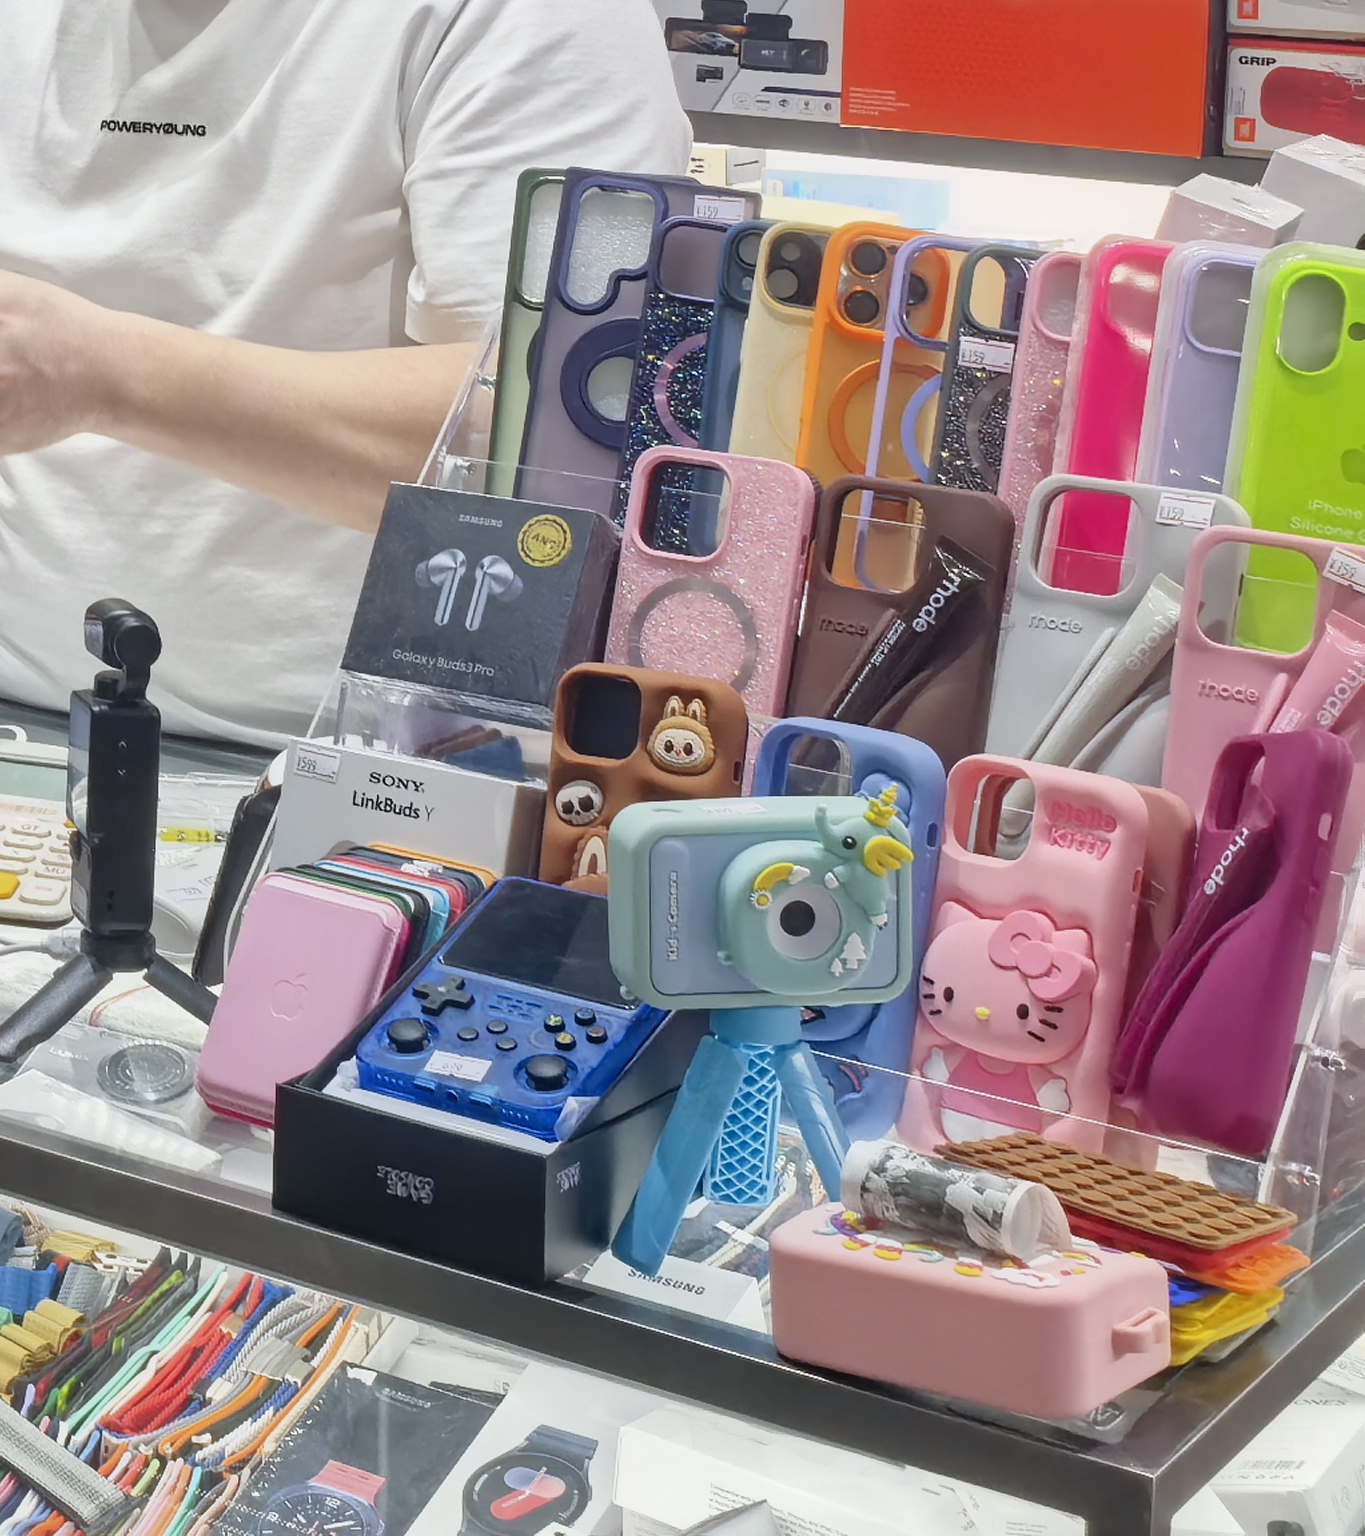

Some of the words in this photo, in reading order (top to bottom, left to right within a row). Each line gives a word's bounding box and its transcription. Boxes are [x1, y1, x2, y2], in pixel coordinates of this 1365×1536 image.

[1238, 55, 1277, 67] GRIP
[459, 513, 503, 528] SAMSUNG
[1308, 499, 1363, 520] iPhone
[1290, 517, 1354, 540] Silicone
[912, 571, 962, 633] rhode
[392, 648, 436, 668] Galaxy
[437, 655, 472, 673] Buds3
[475, 664, 495, 677] Pro
[369, 771, 425, 793] SONY
[353, 790, 420, 819] LinkBuds
[1050, 799, 1118, 833] Hello
[1049, 827, 1112, 861] Kitty
[1204, 827, 1251, 895] rhode
